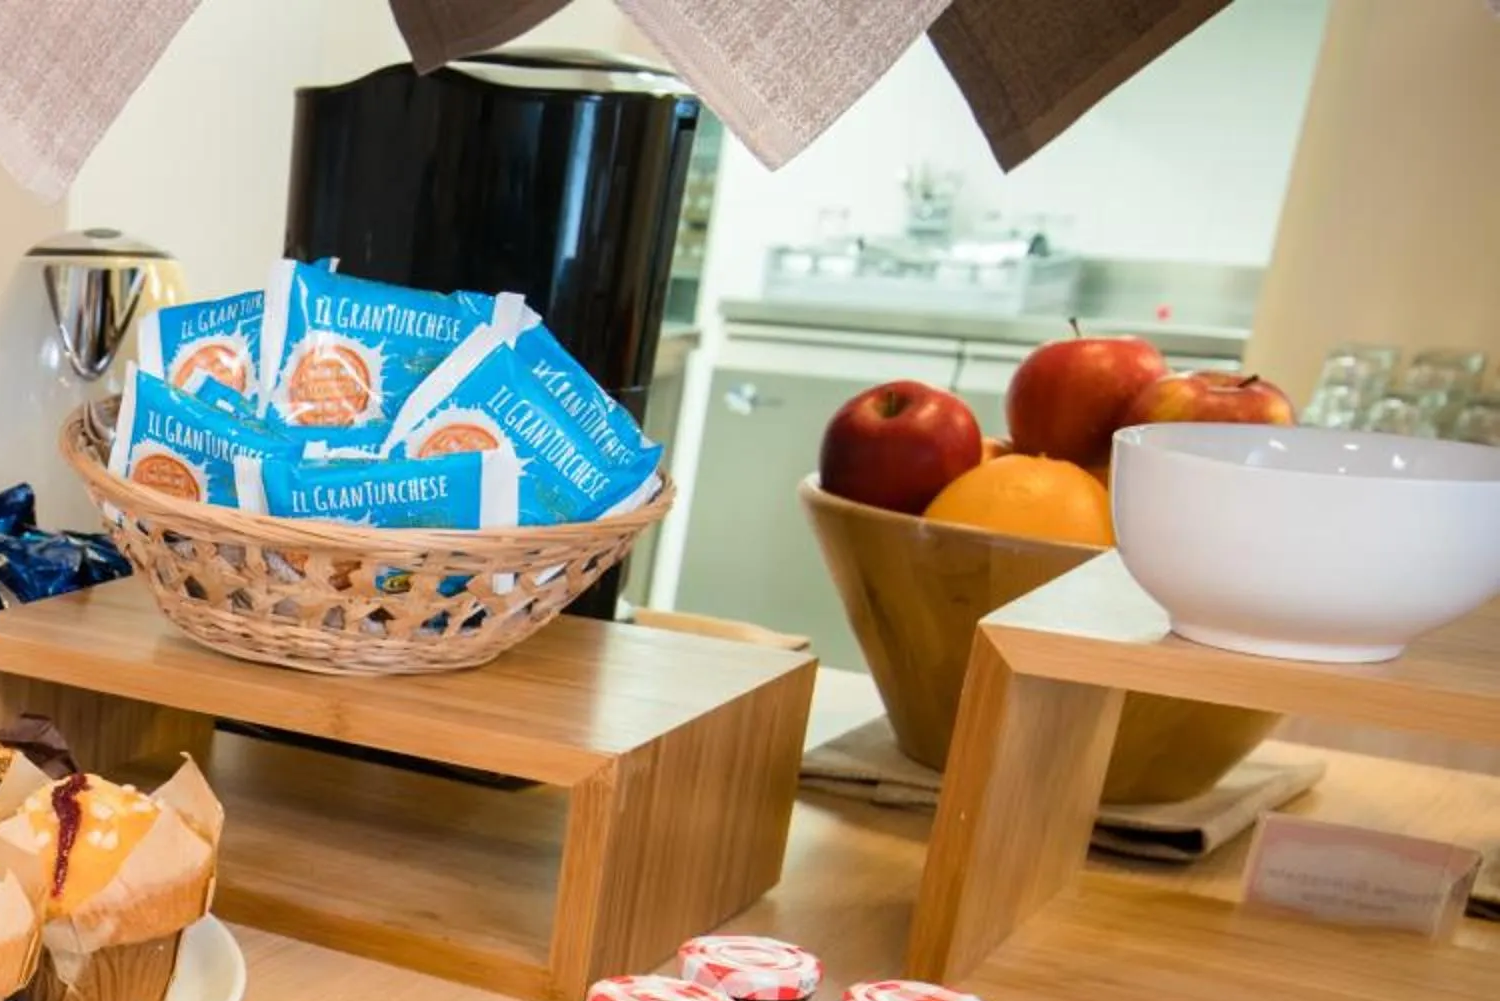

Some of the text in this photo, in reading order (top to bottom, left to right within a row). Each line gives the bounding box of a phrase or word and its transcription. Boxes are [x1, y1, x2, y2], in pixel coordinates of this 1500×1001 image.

[314, 295, 462, 342] IL GRANTURCHESE
[148, 410, 162, 437] IL
[487, 384, 611, 502] IL GRANTURCHESE
[291, 475, 449, 513] IL GRANTURCHESE
